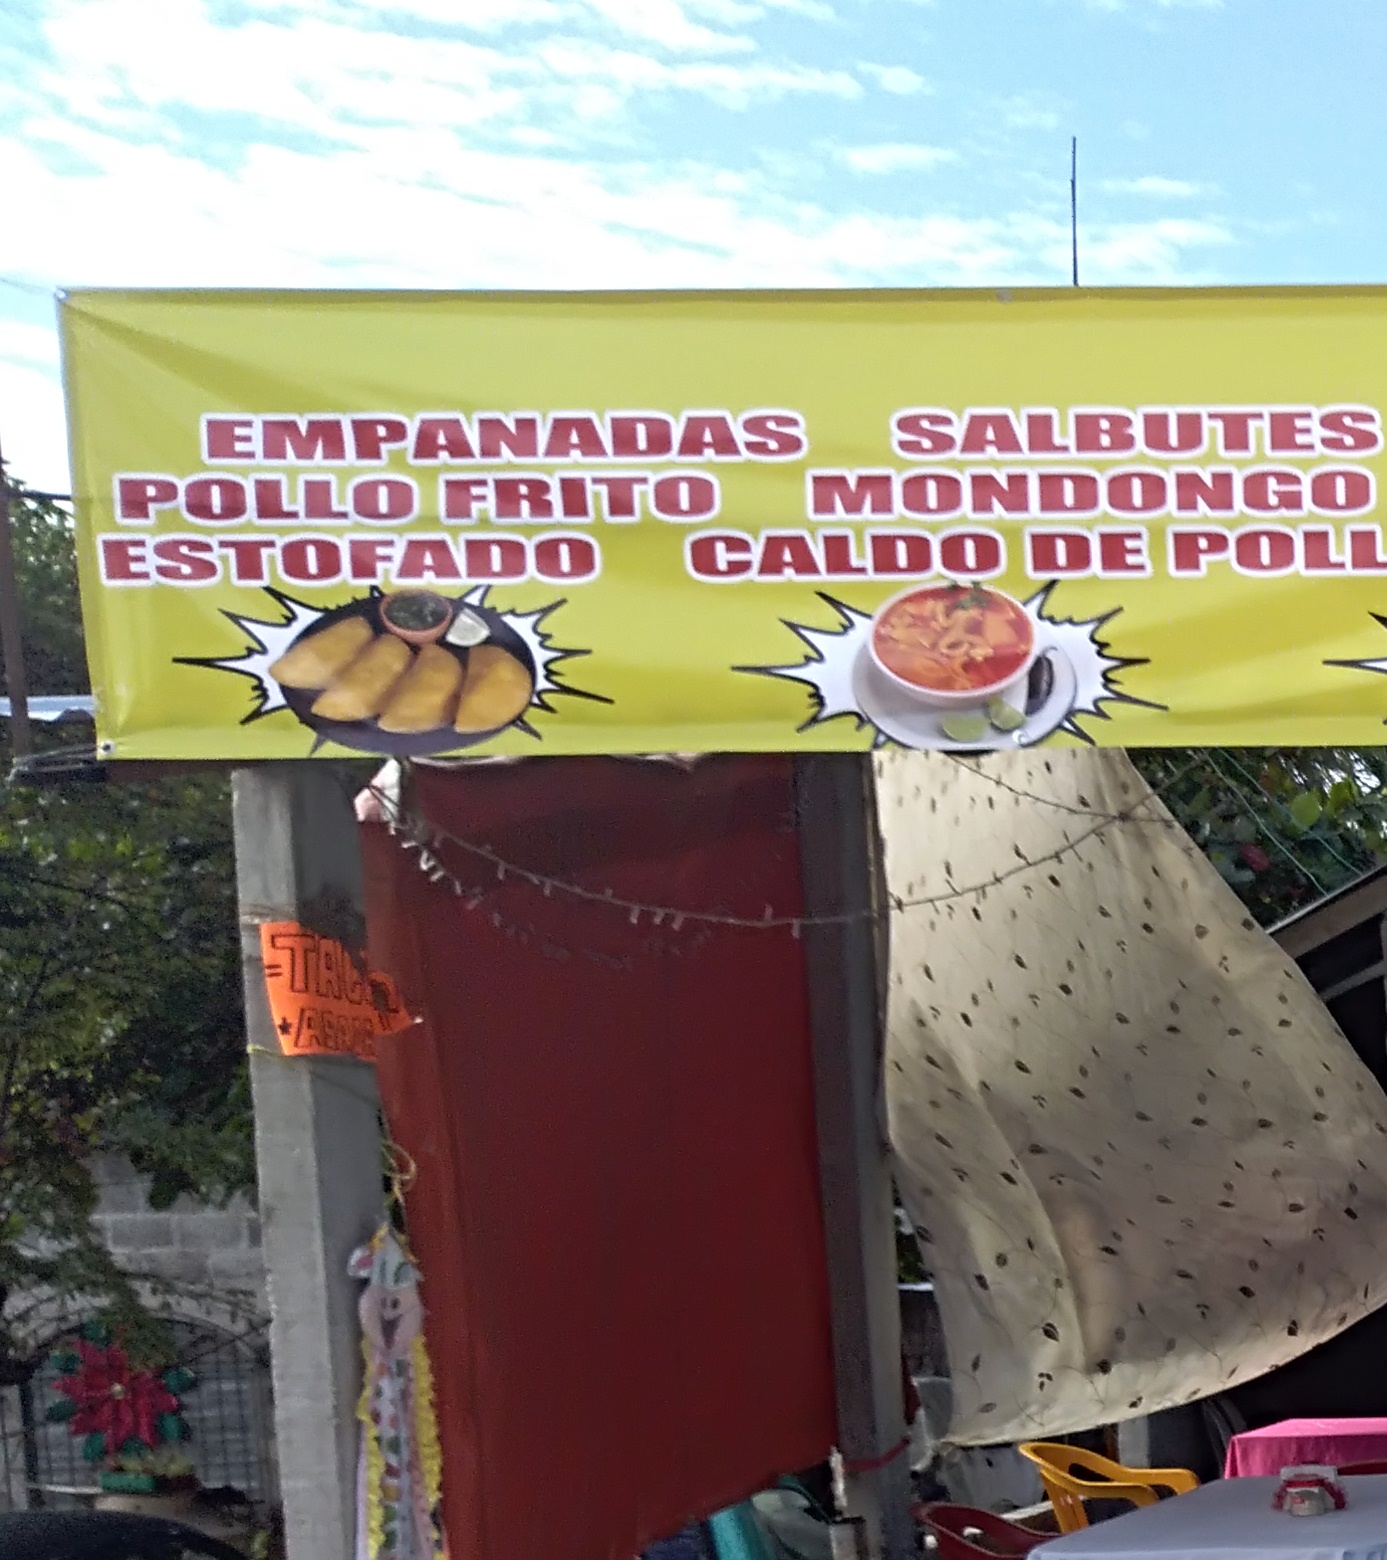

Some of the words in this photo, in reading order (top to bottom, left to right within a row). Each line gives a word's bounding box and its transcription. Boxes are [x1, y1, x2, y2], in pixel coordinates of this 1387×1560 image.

[205, 411, 806, 464] EMPANADAS
[893, 408, 1382, 458] SALBUTES
[118, 475, 417, 524] POLLO
[441, 472, 718, 522] FRITO
[808, 466, 1375, 518] MONDONGO
[100, 533, 599, 585] ESTOFADO
[686, 528, 1005, 581] CALDO
[1026, 528, 1147, 576] DE
